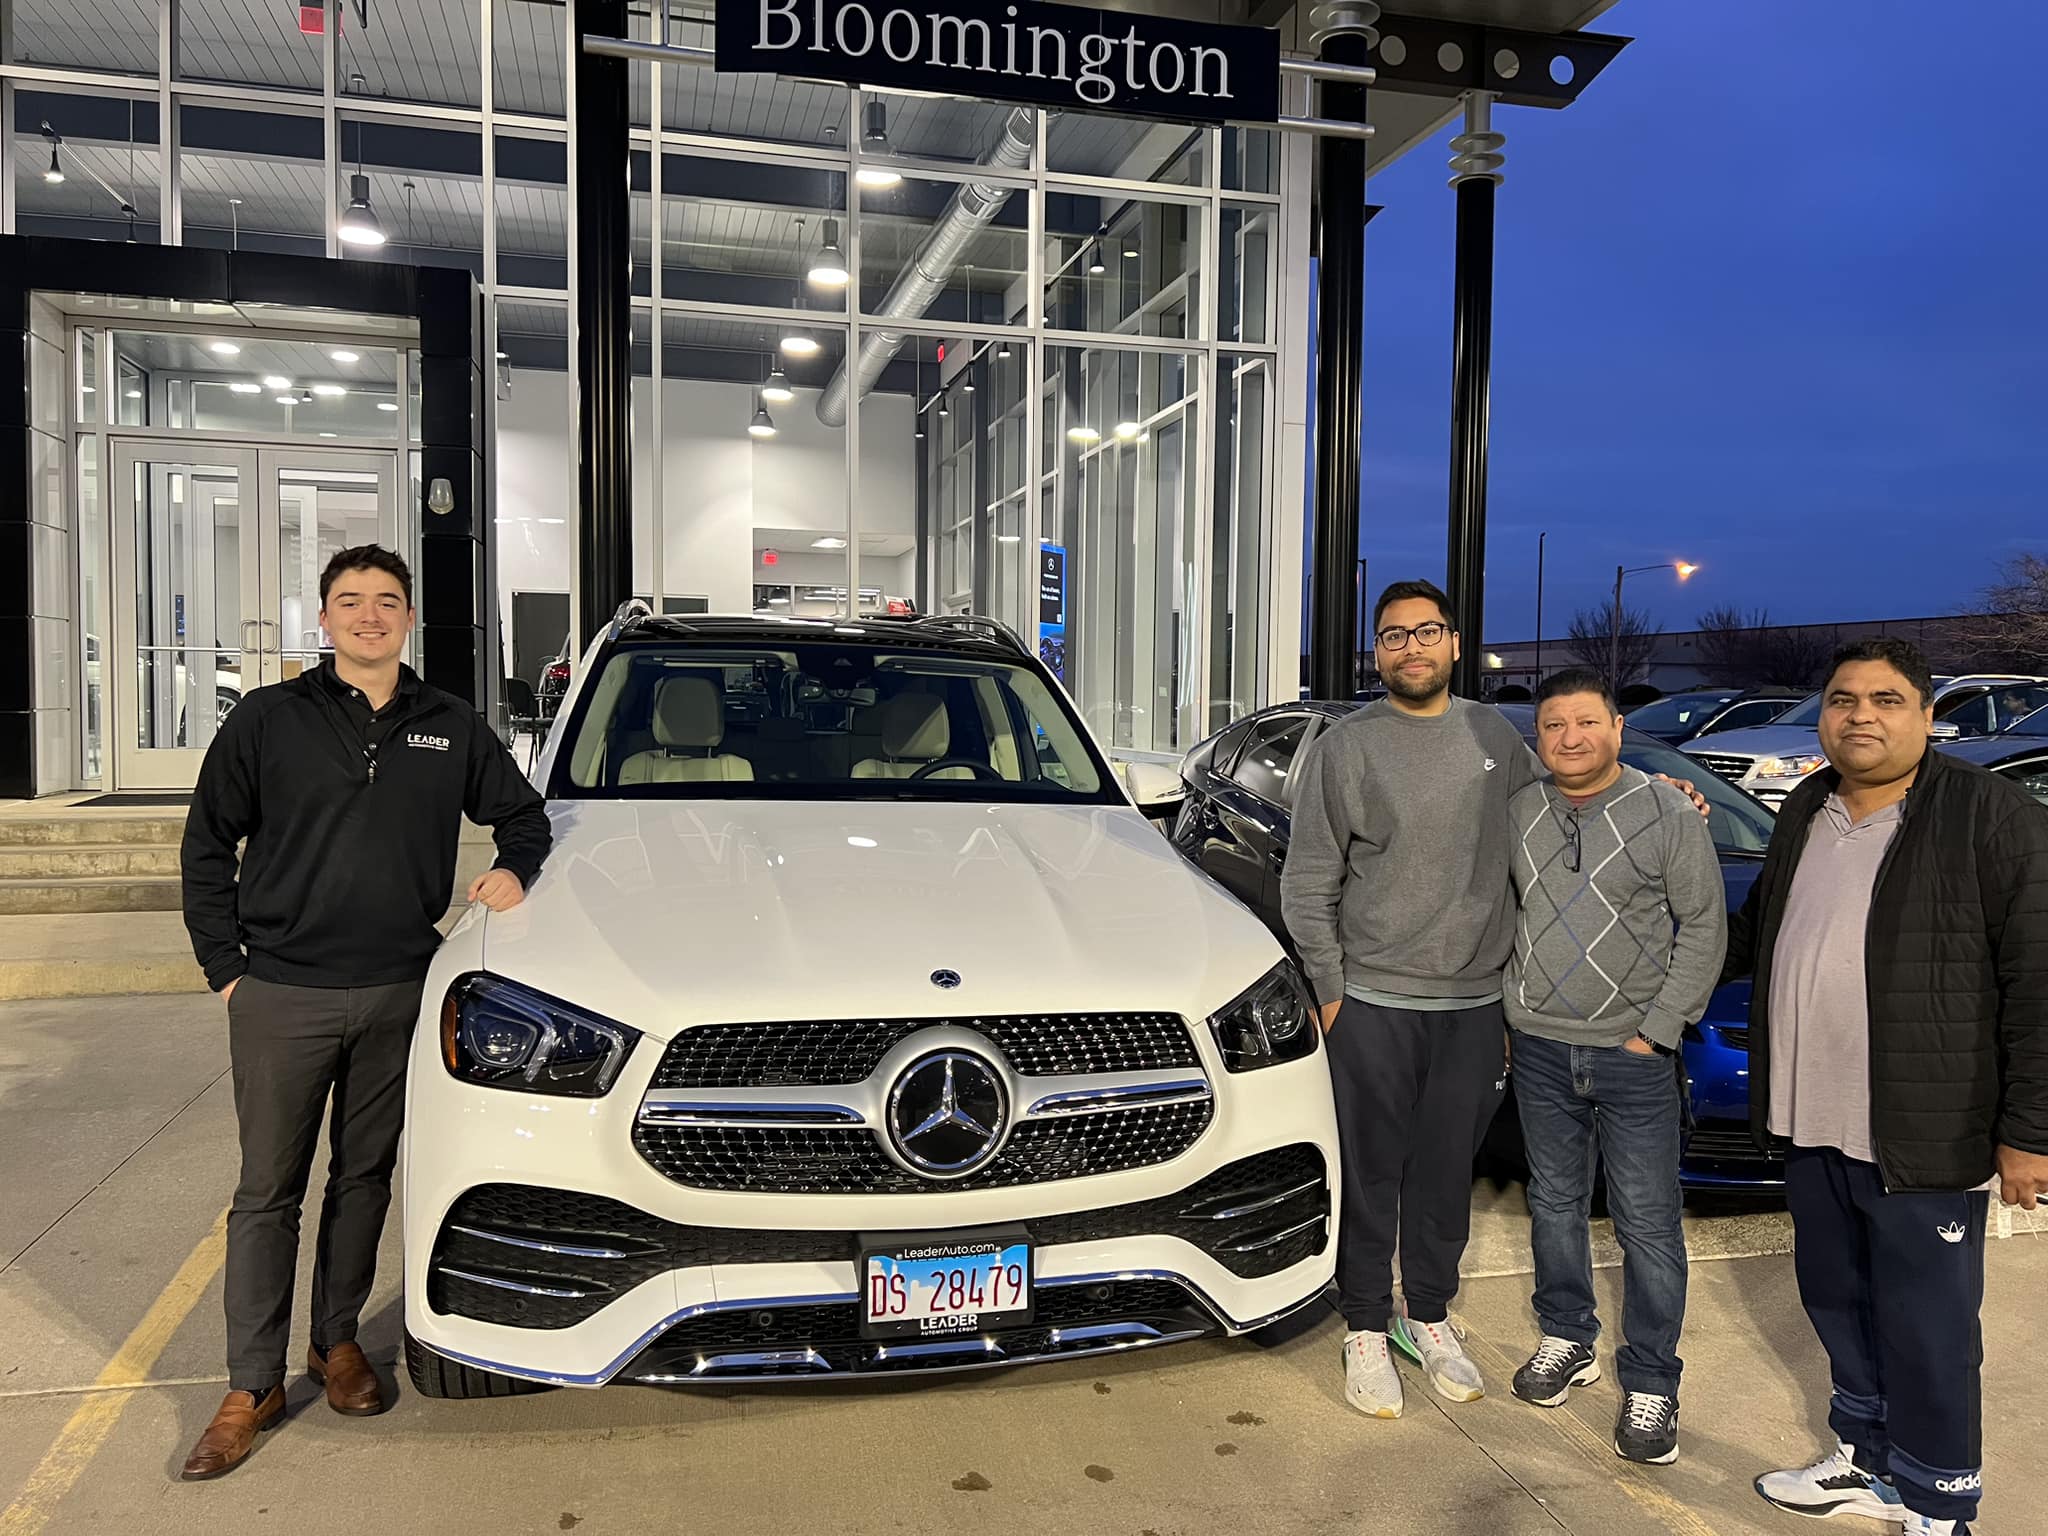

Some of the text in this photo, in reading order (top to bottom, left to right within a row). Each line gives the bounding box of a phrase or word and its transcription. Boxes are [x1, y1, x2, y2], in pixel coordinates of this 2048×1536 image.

[752, 0, 1234, 104] Bloomington
[407, 733, 450, 747] LEADER
[904, 1243, 995, 1259] LeaderAuto.com
[871, 1264, 1023, 1317] DS 28479
[920, 1314, 978, 1330] LEADER
